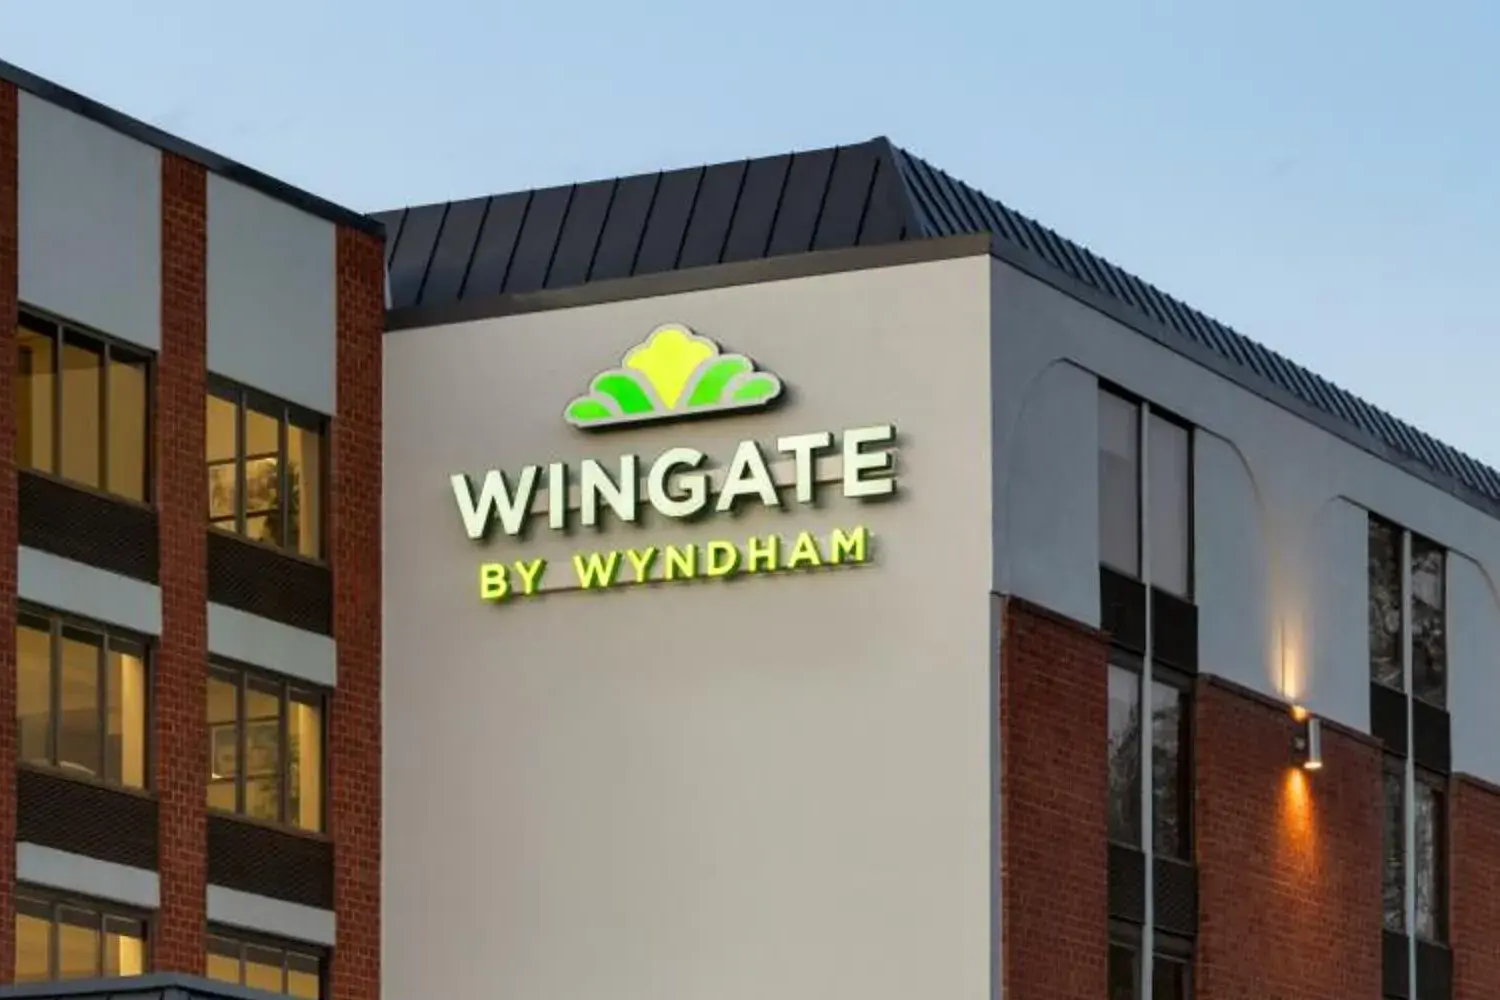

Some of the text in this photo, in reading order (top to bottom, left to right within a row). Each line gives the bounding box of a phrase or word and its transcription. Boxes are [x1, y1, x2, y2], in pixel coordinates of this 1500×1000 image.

[451, 424, 897, 539] WINGATE
[480, 526, 870, 600] BY WYNDHAM
